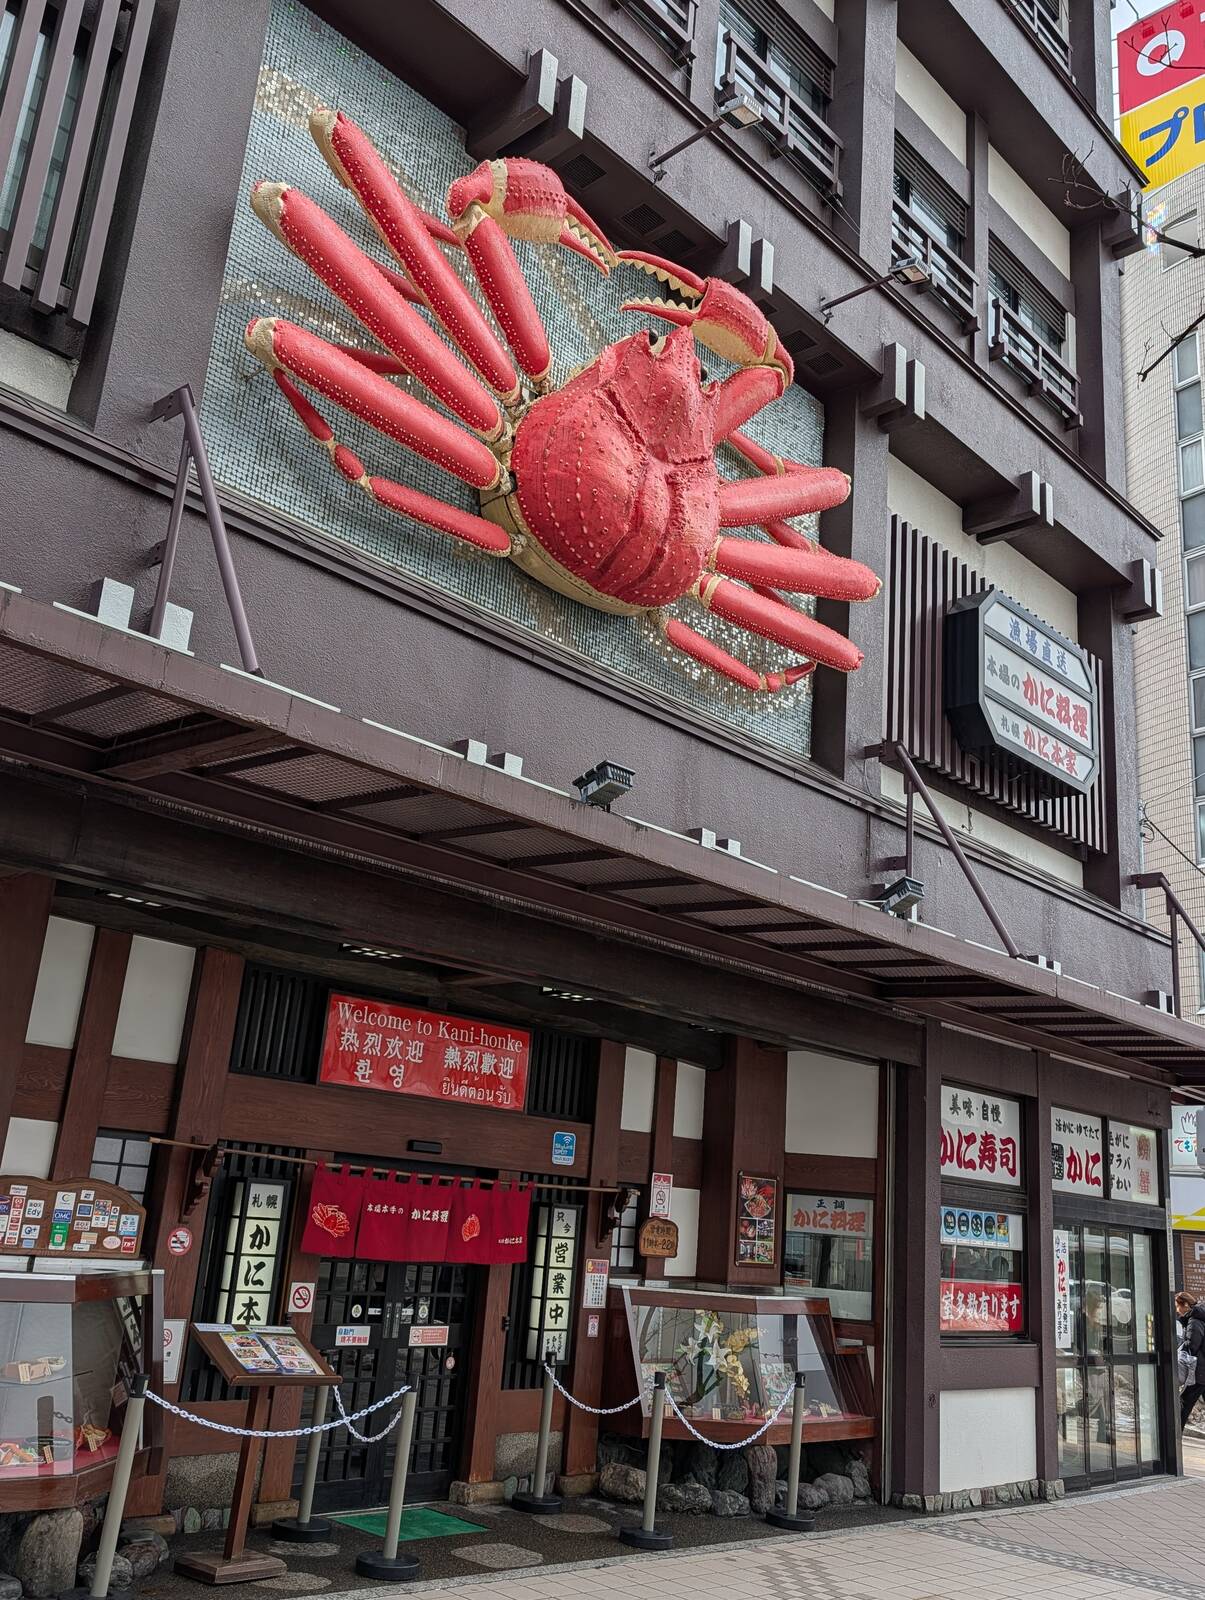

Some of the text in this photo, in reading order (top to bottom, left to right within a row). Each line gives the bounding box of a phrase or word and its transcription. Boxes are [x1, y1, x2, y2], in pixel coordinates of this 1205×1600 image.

[1139, 103, 1205, 168] プ
[1008, 616, 1068, 675] 漁場直送
[986, 654, 1088, 741] 本場の かに料理
[1000, 714, 1079, 776] 札幌 かに本家
[336, 1001, 523, 1053] Welcome to Kani-honke
[339, 1026, 515, 1079] 热烈欢迎 熱烈歡迎
[941, 1125, 1016, 1178] かに寿司
[1065, 1145, 1101, 1188] かに
[27, 1208, 42, 1217] Edy
[54, 1211, 71, 1220] OMC
[251, 1193, 279, 1210] 札幌
[793, 1207, 866, 1233] かに料理
[549, 1241, 569, 1325] 営業中
